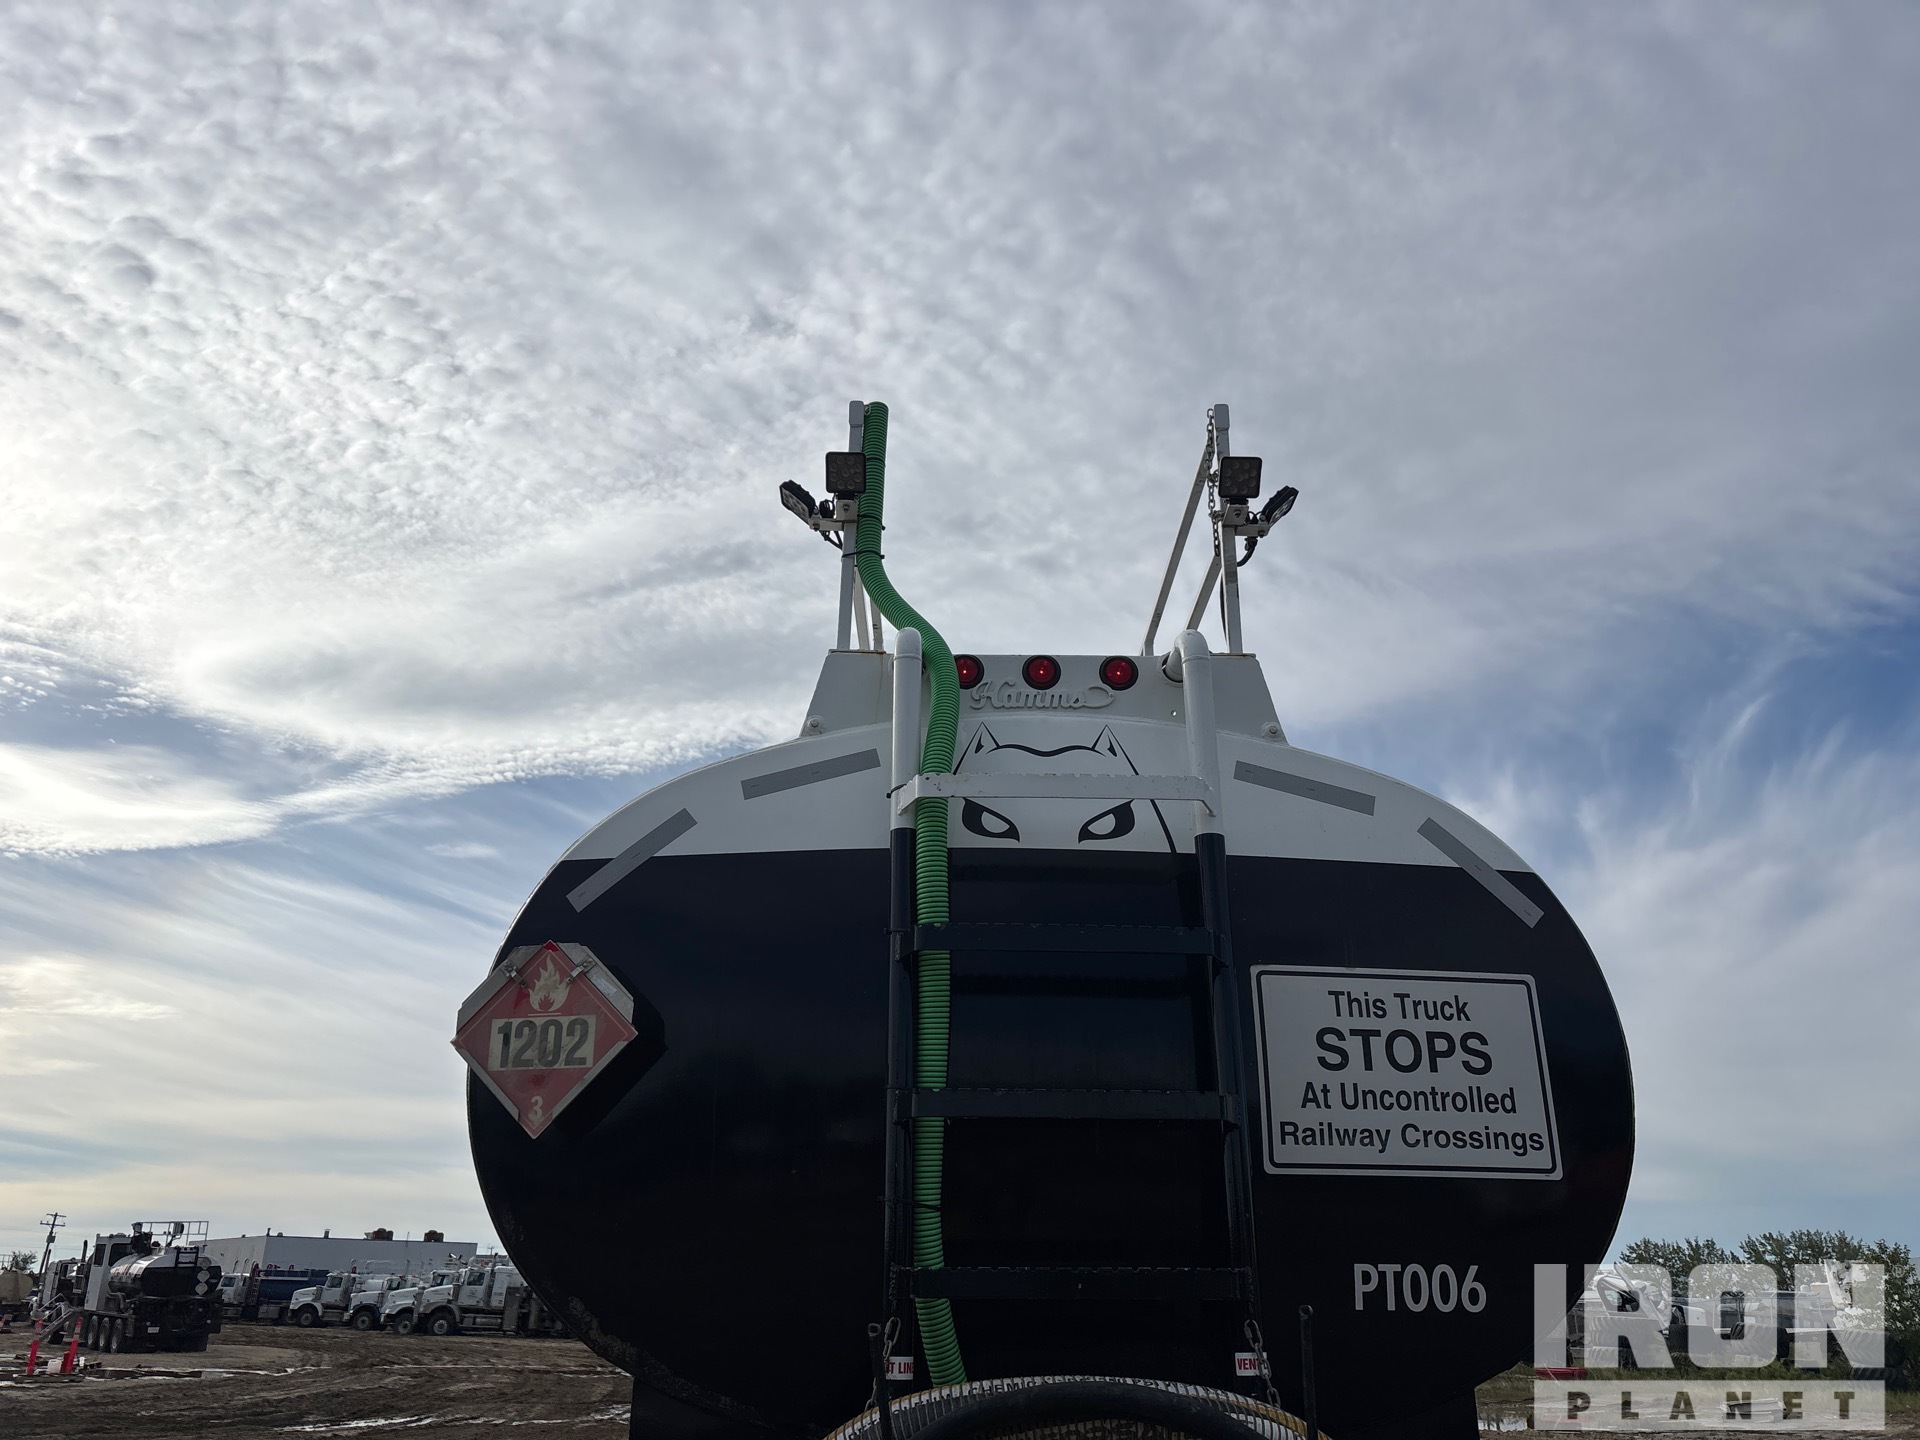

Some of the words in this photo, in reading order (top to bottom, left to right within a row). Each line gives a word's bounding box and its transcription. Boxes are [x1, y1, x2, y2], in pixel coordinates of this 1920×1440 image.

[1327, 990, 1388, 1019] This
[1393, 992, 1471, 1021] Truck
[497, 1017, 590, 1069] 1202
[1315, 1026, 1493, 1075] STOPS
[527, 1095, 544, 1122] 3
[1301, 1081, 1332, 1110] At
[1340, 1082, 1517, 1114] Uncontrolled
[1279, 1121, 1391, 1154] Railway
[1400, 1123, 1545, 1157] Crossings
[1353, 1263, 1487, 1313] PT006
